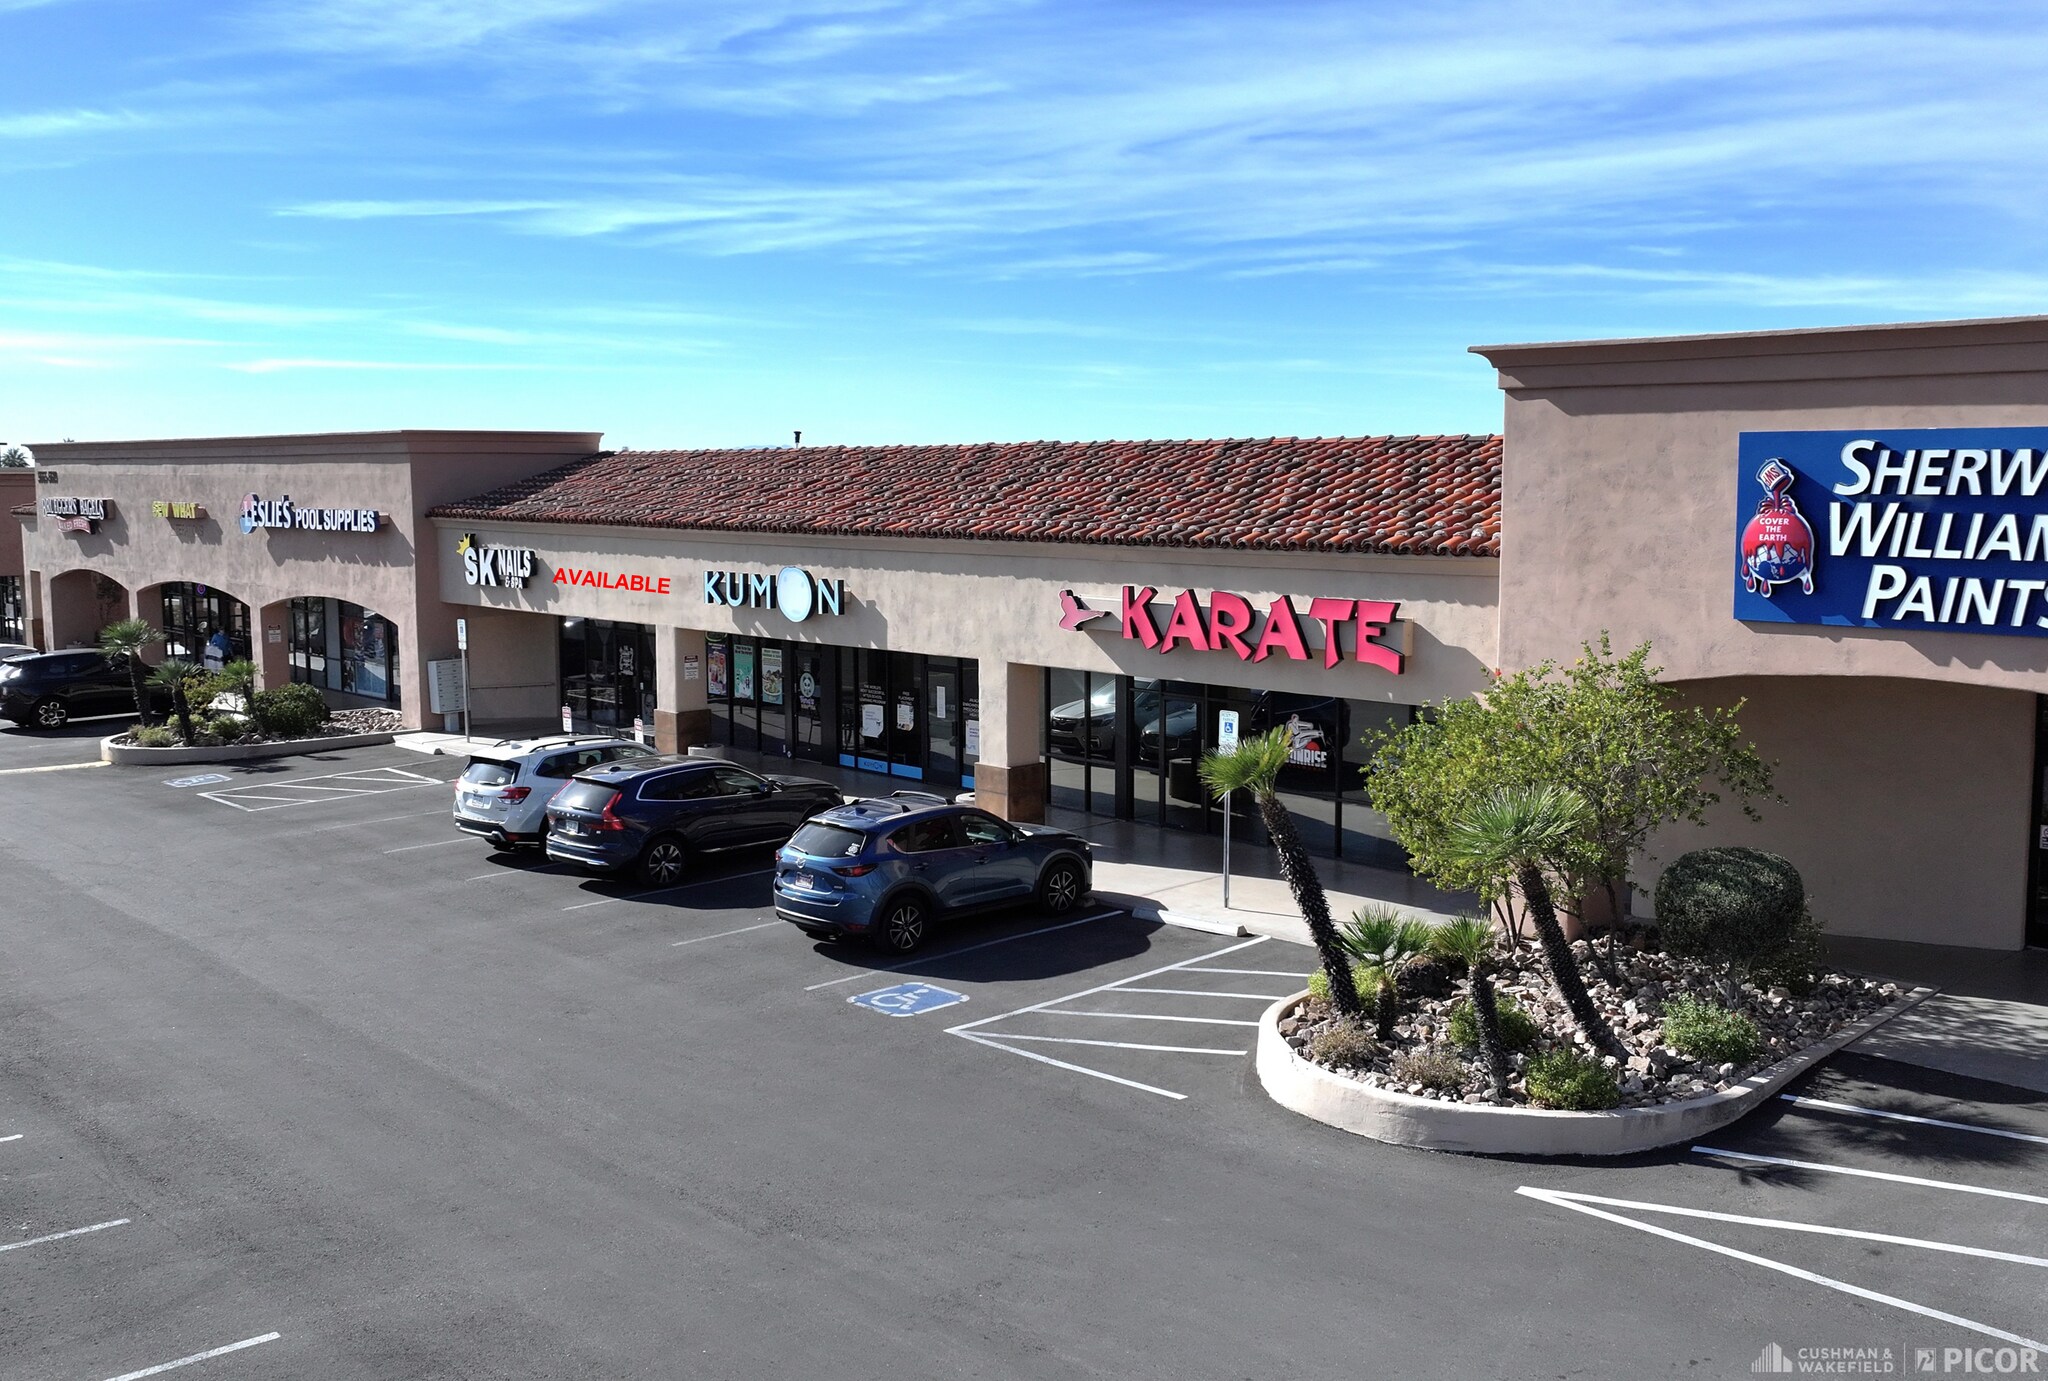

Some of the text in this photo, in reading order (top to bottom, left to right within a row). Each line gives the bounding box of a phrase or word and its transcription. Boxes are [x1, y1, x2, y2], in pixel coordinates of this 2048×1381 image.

[172, 501, 196, 519] WHAT
[243, 495, 376, 533] LESLIE'S POOL SUPPLIES
[1759, 517, 1790, 525] COVER
[1765, 525, 1782, 533] THE
[1759, 534, 1788, 542] EARTH
[464, 546, 532, 587] SK NAILS
[504, 576, 523, 590] & SPA
[703, 566, 844, 623] KUMON
[1122, 585, 1404, 676] KARATE
[1285, 749, 1328, 768] UNRISE
